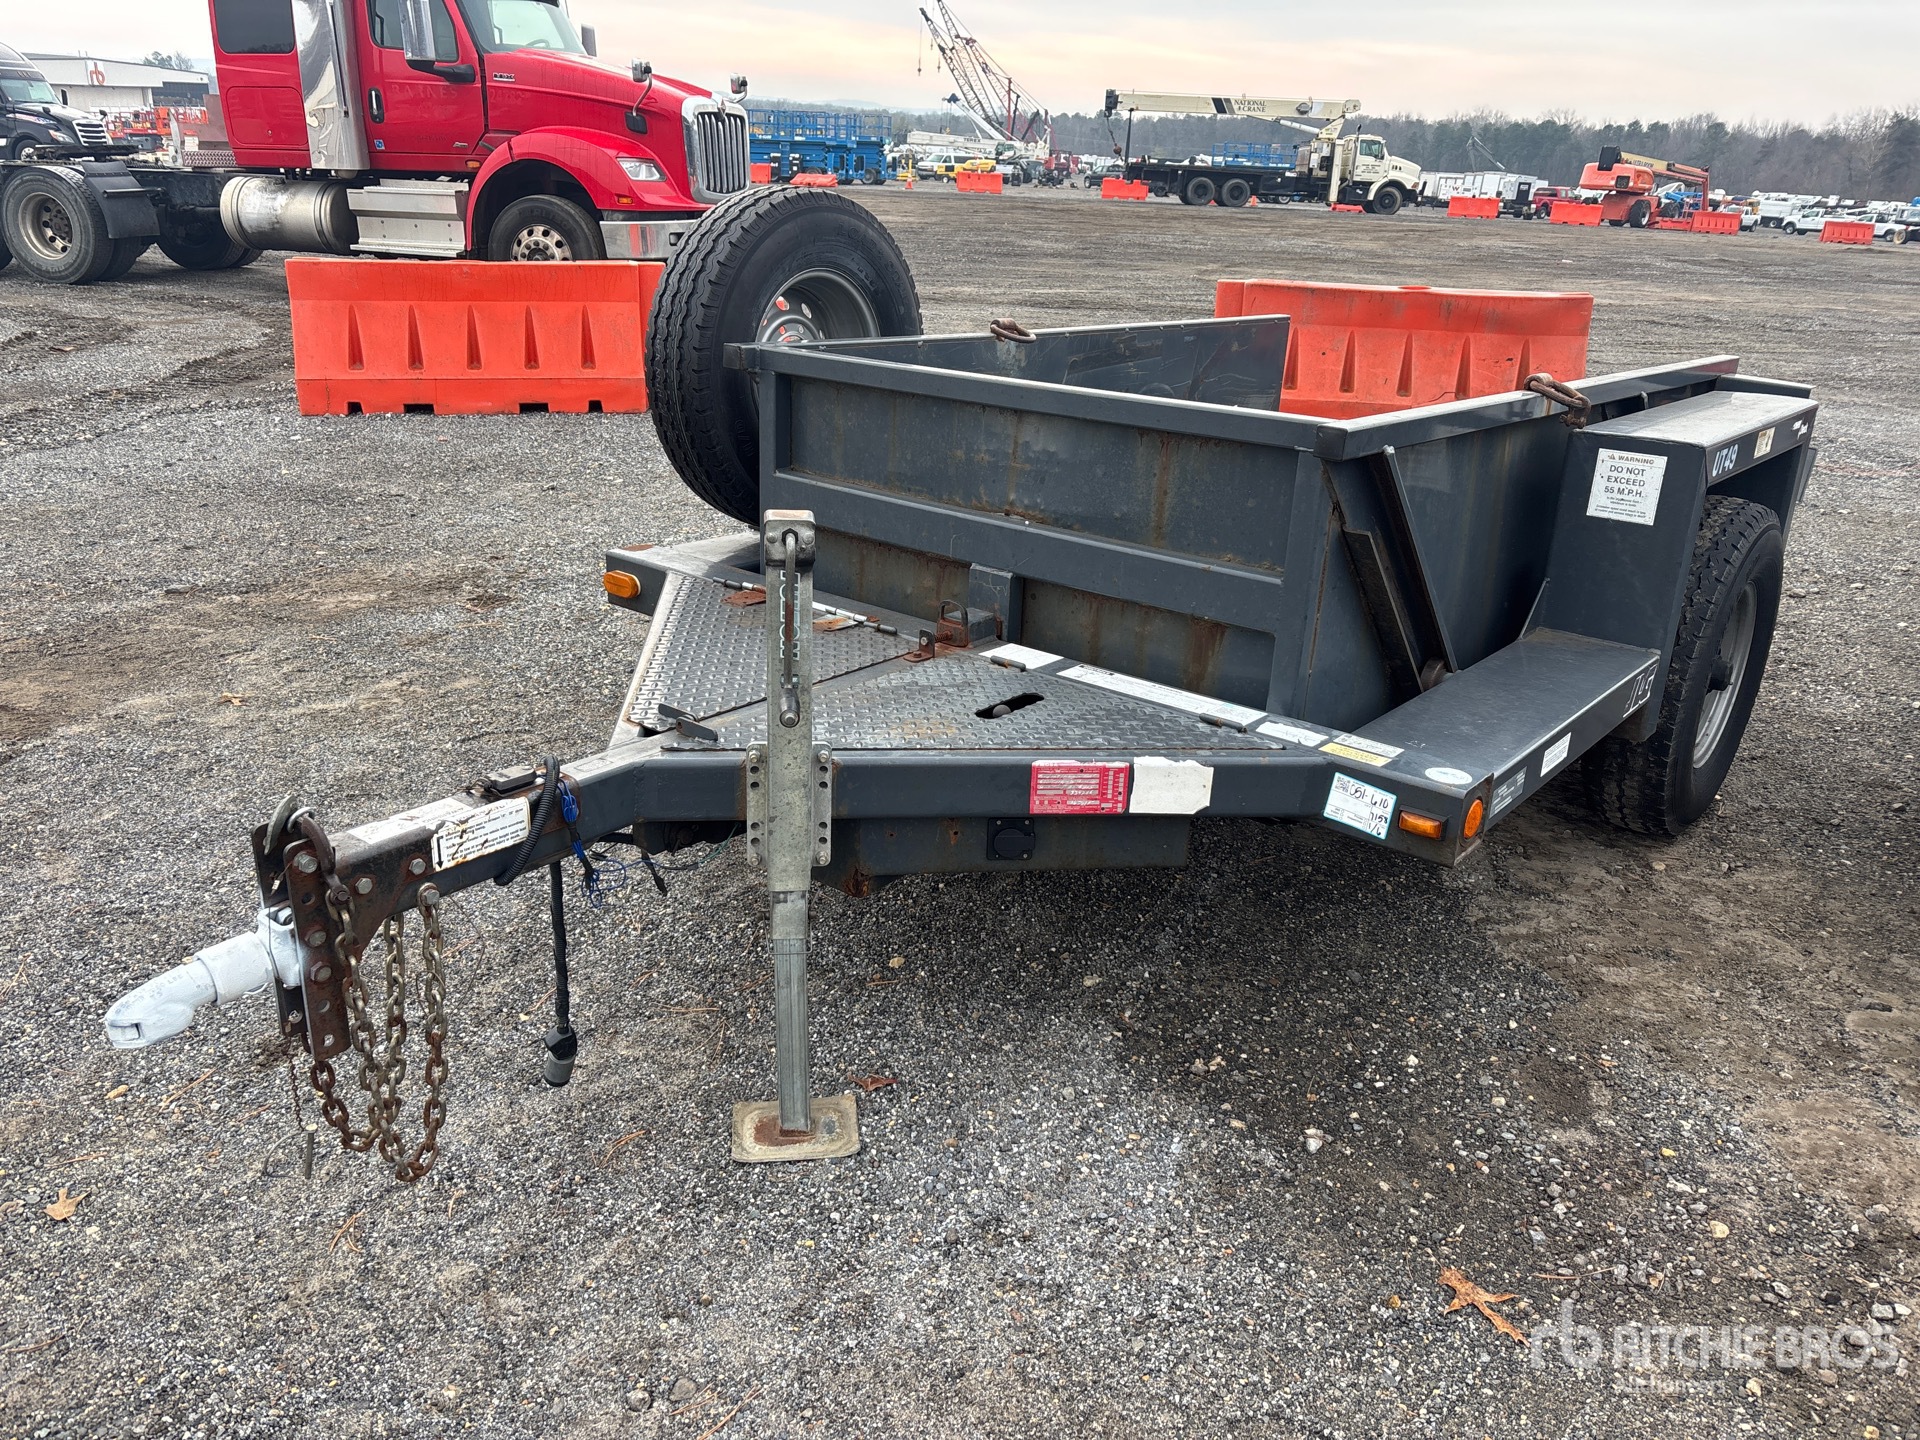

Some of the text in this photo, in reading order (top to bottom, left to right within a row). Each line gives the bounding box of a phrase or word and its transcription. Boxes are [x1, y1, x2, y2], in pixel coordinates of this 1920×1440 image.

[1234, 99, 1267, 107] NATIONAL
[1618, 454, 1654, 465] WARNING
[1712, 443, 1739, 477] UT49
[1609, 464, 1646, 477] DO NOT
[1607, 475, 1646, 487] EXCEED
[1604, 485, 1644, 498] 55 M.P.H.
